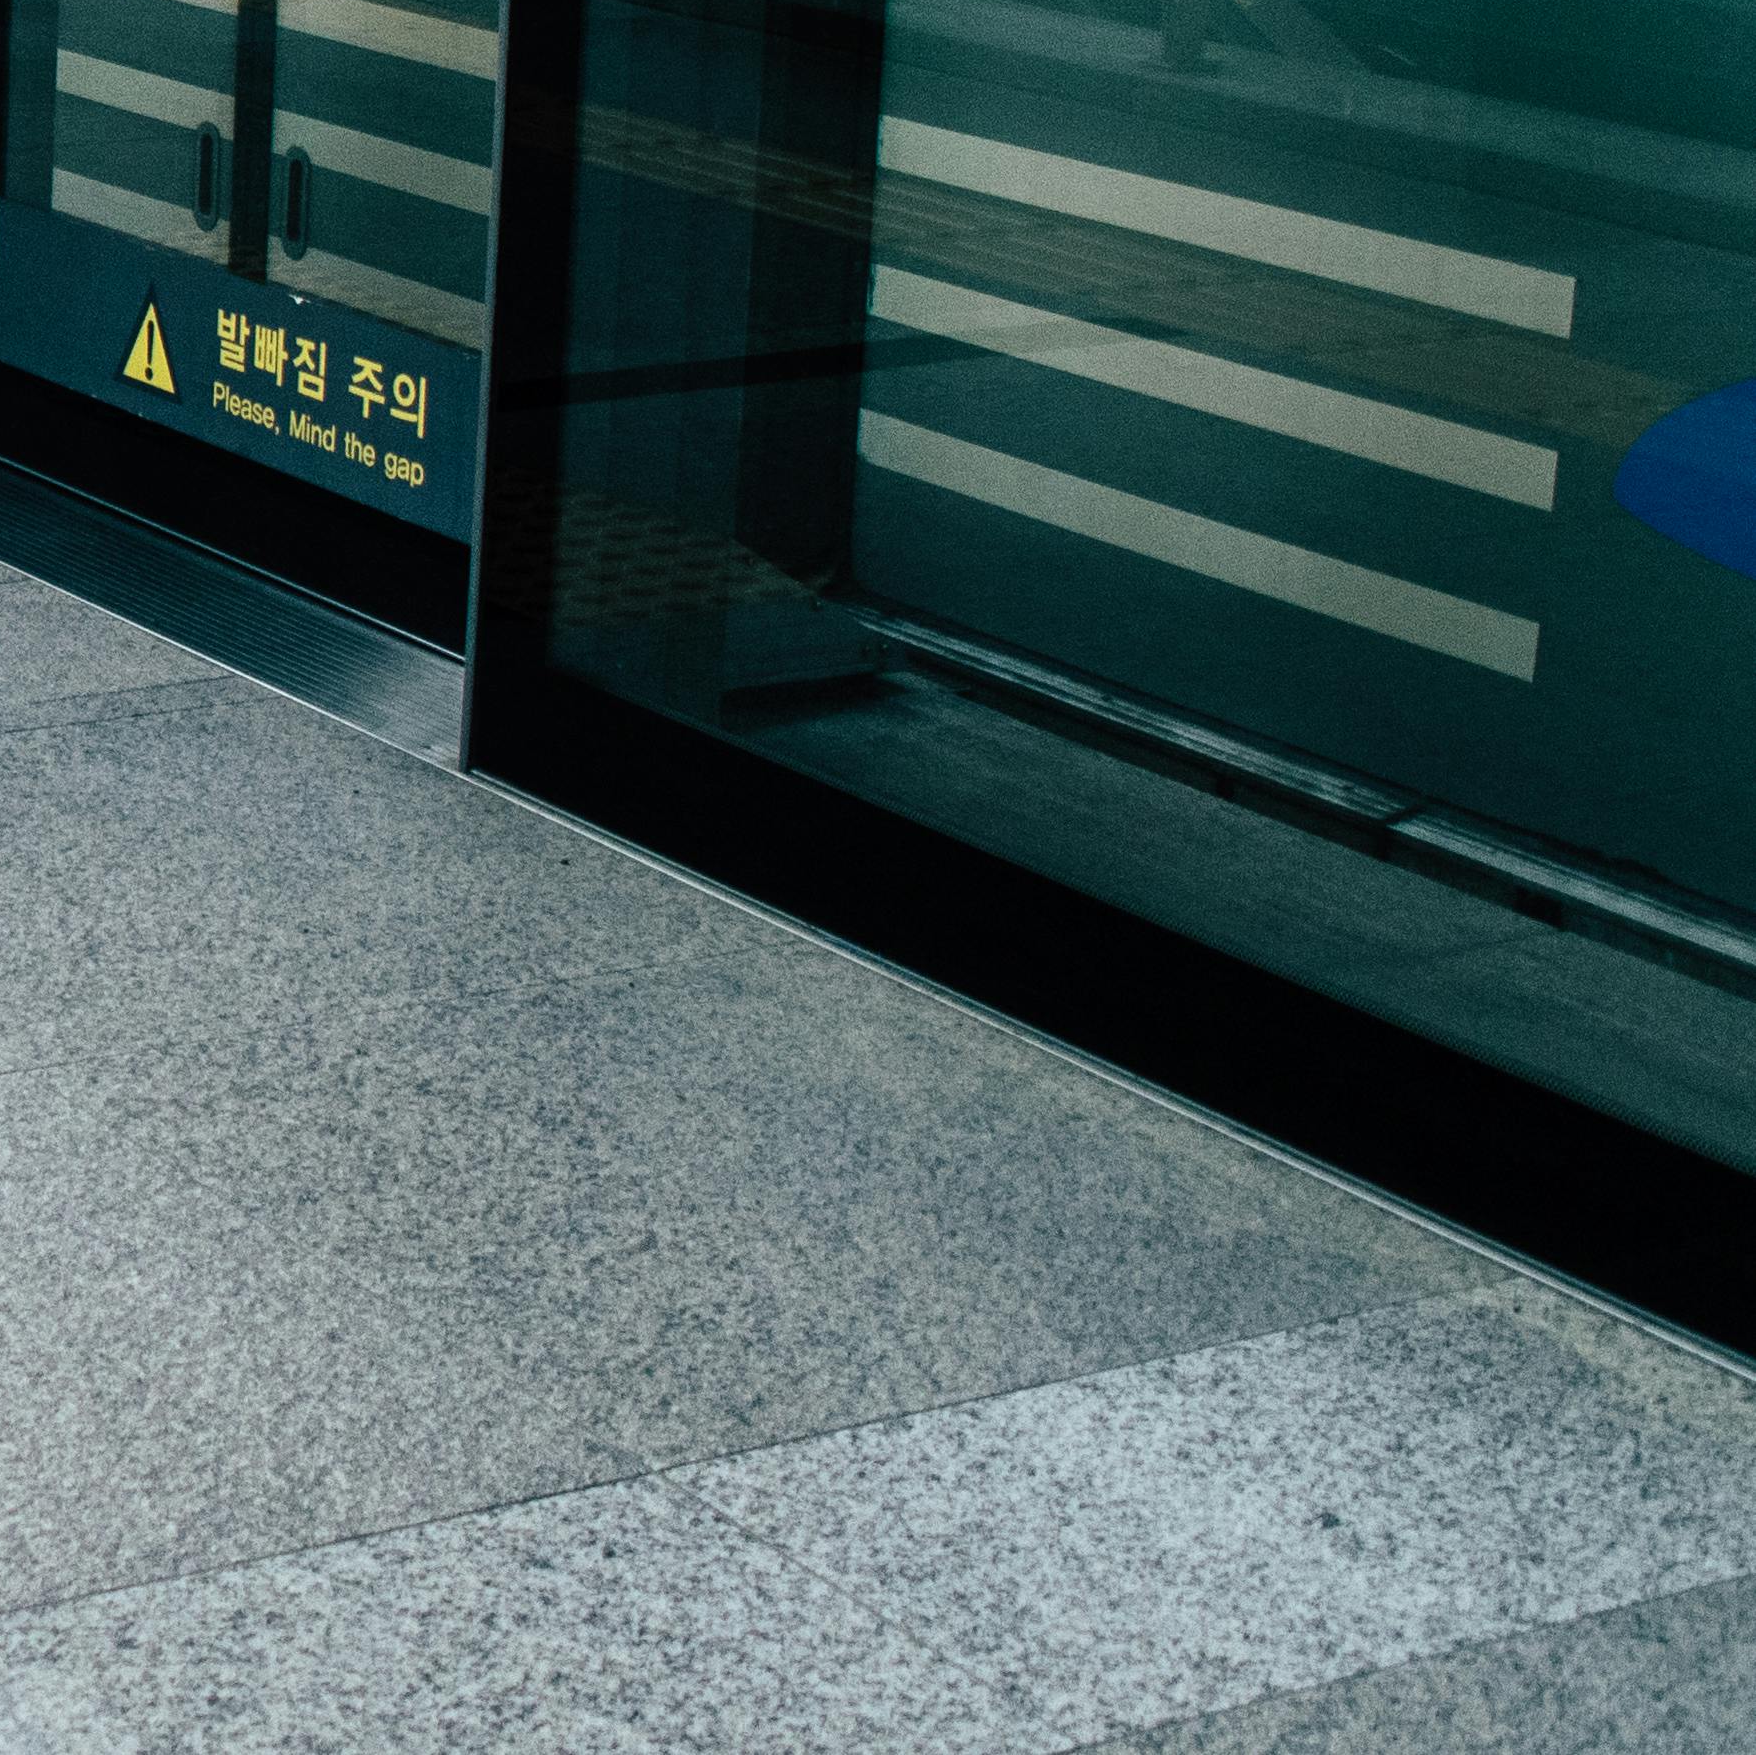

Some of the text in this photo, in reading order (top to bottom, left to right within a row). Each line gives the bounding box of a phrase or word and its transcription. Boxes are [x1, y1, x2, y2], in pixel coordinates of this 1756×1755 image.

[216, 308, 427, 440] 발빠짐 주의
[212, 381, 425, 488] Please, Mind the gap
